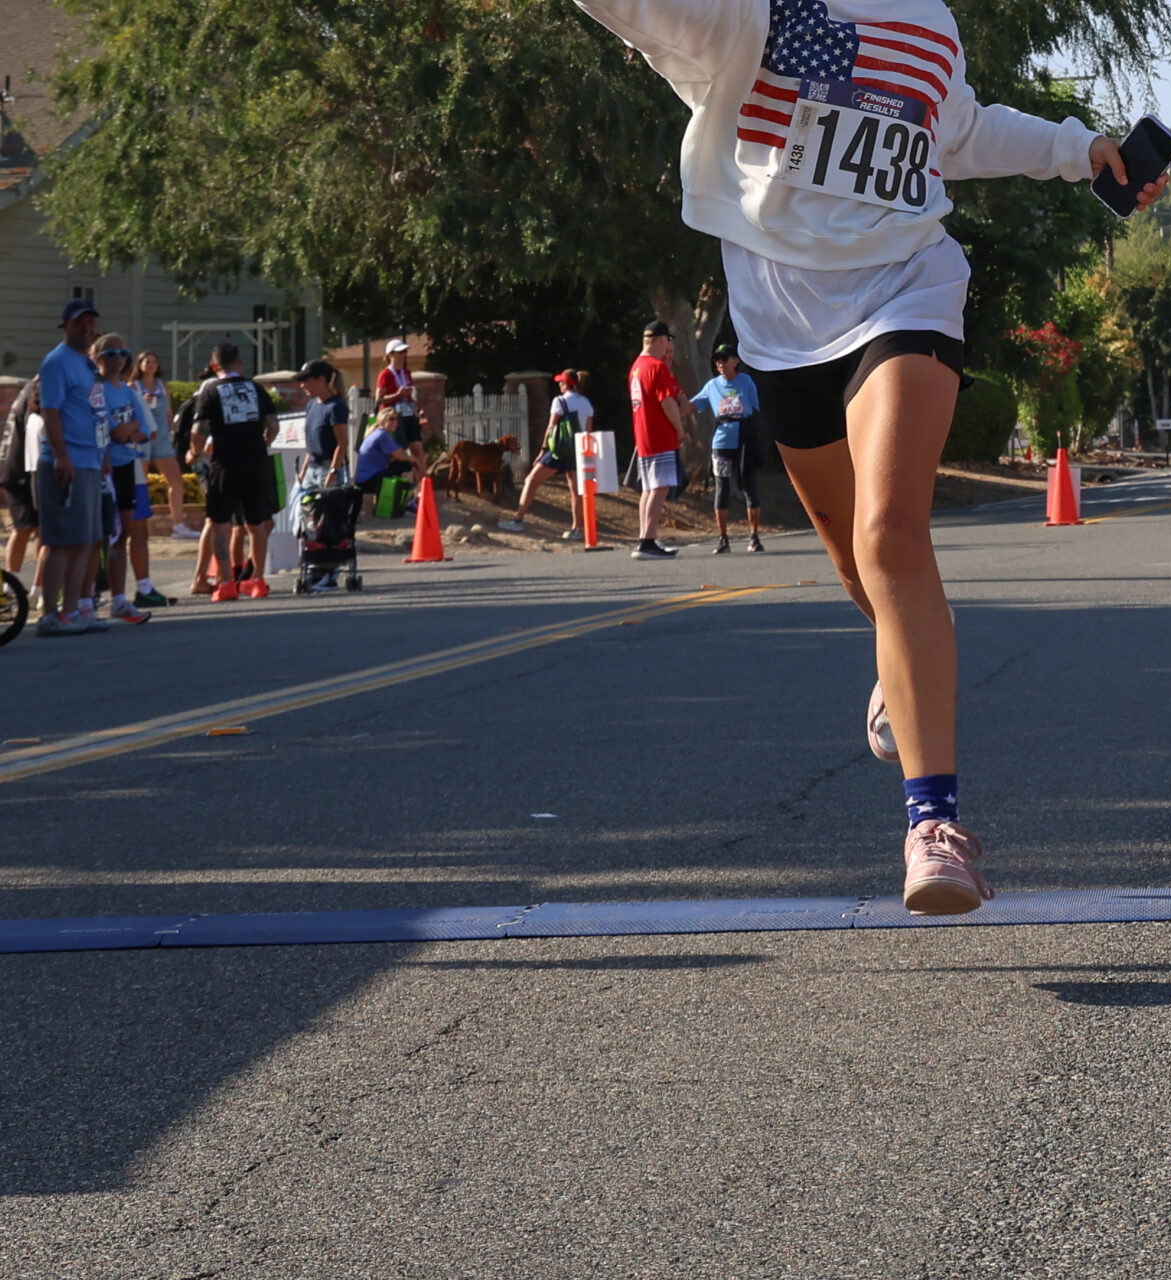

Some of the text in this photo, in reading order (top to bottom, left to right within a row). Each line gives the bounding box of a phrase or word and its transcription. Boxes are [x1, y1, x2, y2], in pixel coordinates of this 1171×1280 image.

[859, 102, 901, 117] RESULTS
[863, 92, 904, 108] FINISHED
[788, 144, 805, 171] 1438
[812, 109, 930, 207] 1438
